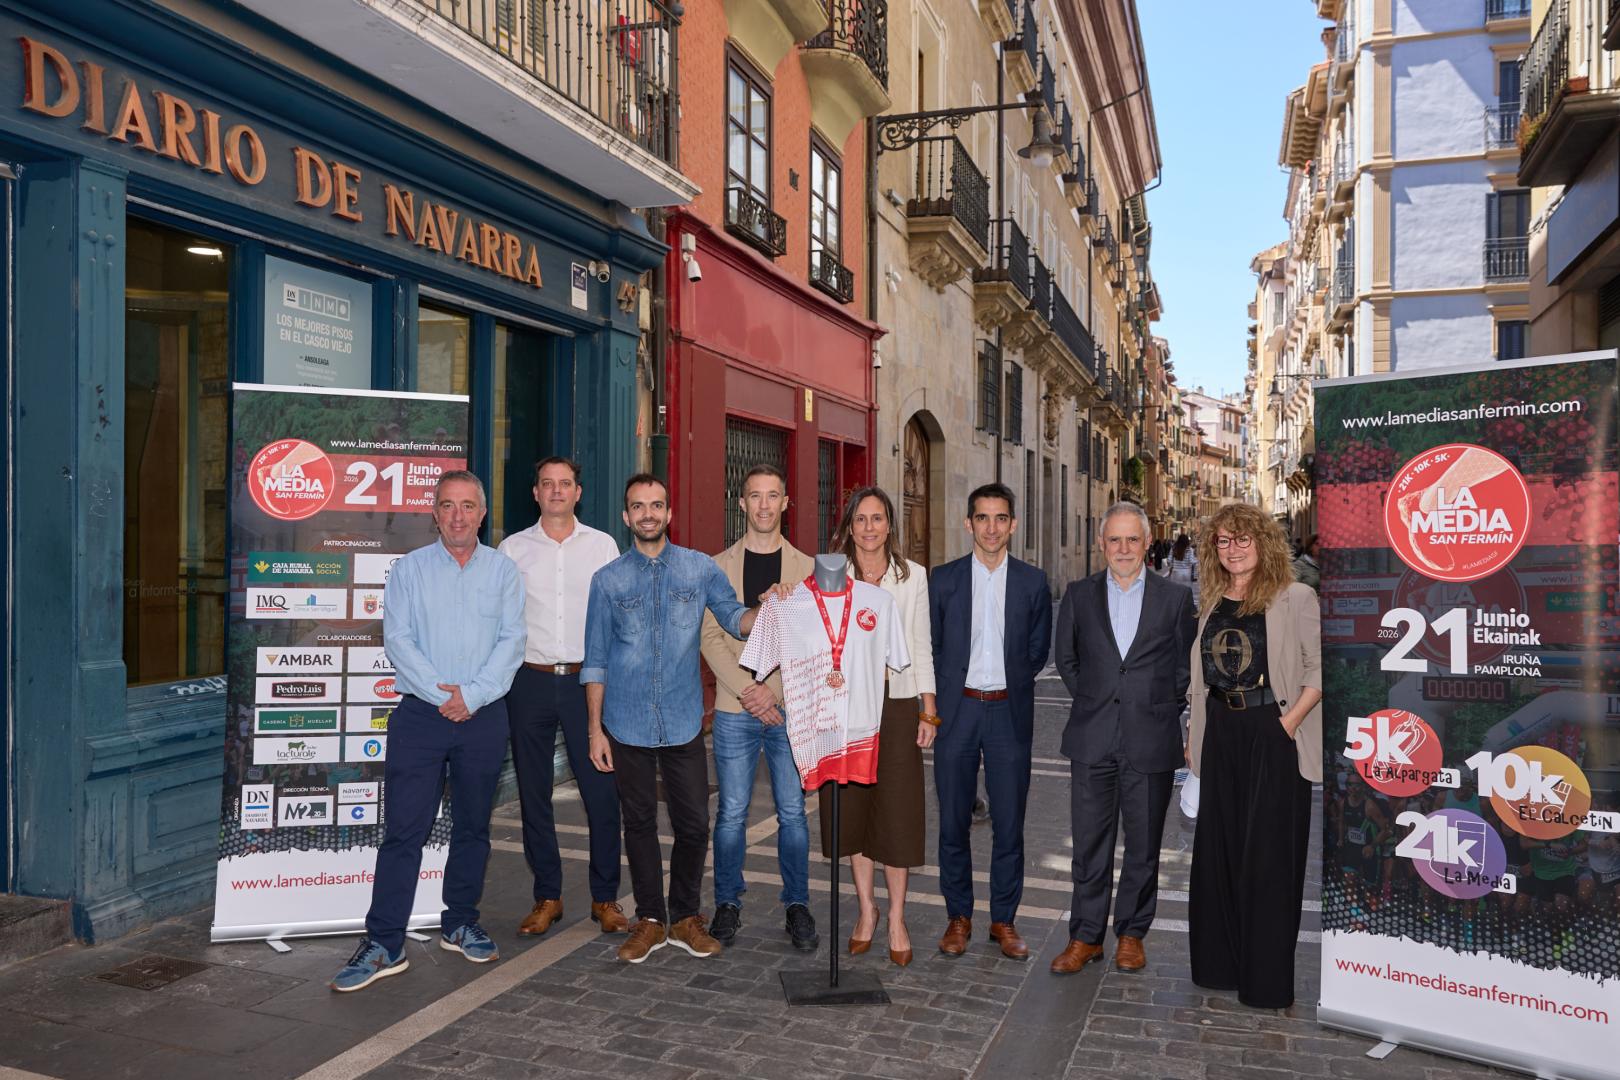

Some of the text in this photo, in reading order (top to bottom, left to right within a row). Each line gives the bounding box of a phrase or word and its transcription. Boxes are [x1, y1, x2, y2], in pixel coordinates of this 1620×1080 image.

[17, 36, 542, 288] DIARIO DE NAVARRA
[276, 313, 353, 340] LOS MEJORES PISOS
[280, 328, 352, 354] EN EL CASCO VIEJO
[1342, 400, 1581, 429] www.lamediasanfermin.com
[330, 440, 462, 452] www.lamediasanfermin.com
[281, 464, 305, 478] LA
[408, 462, 442, 475] Junio
[1399, 453, 1448, 491] 21K 10K 5K
[264, 476, 324, 492] MEDIA
[344, 461, 404, 505] 21
[407, 475, 440, 486] Ekain
[294, 491, 325, 499] FERMÍN
[1437, 486, 1478, 510] LA
[1410, 508, 1512, 533] MEDIA
[323, 540, 382, 548] PATROCINADORES
[1429, 531, 1513, 544] SAN FERMÍN
[256, 594, 290, 610] IMQ
[1474, 608, 1530, 628] Junio
[1378, 629, 1399, 639] 2026
[1380, 607, 1468, 675] 21
[1473, 628, 1541, 646] Ekainak
[278, 654, 333, 666] AMBAR
[1503, 653, 1541, 666] IRUÑA
[1474, 665, 1542, 677] PAMPLONA
[1342, 716, 1414, 765] 5k
[1364, 763, 1381, 779] La
[1464, 751, 1565, 805] 10k
[247, 790, 269, 803] DN
[1395, 811, 1479, 868] 21k
[231, 869, 443, 890] www.lamediasanfeom
[1444, 867, 1462, 885] La
[1336, 958, 1609, 1025] www.lamediasanfermin.com
